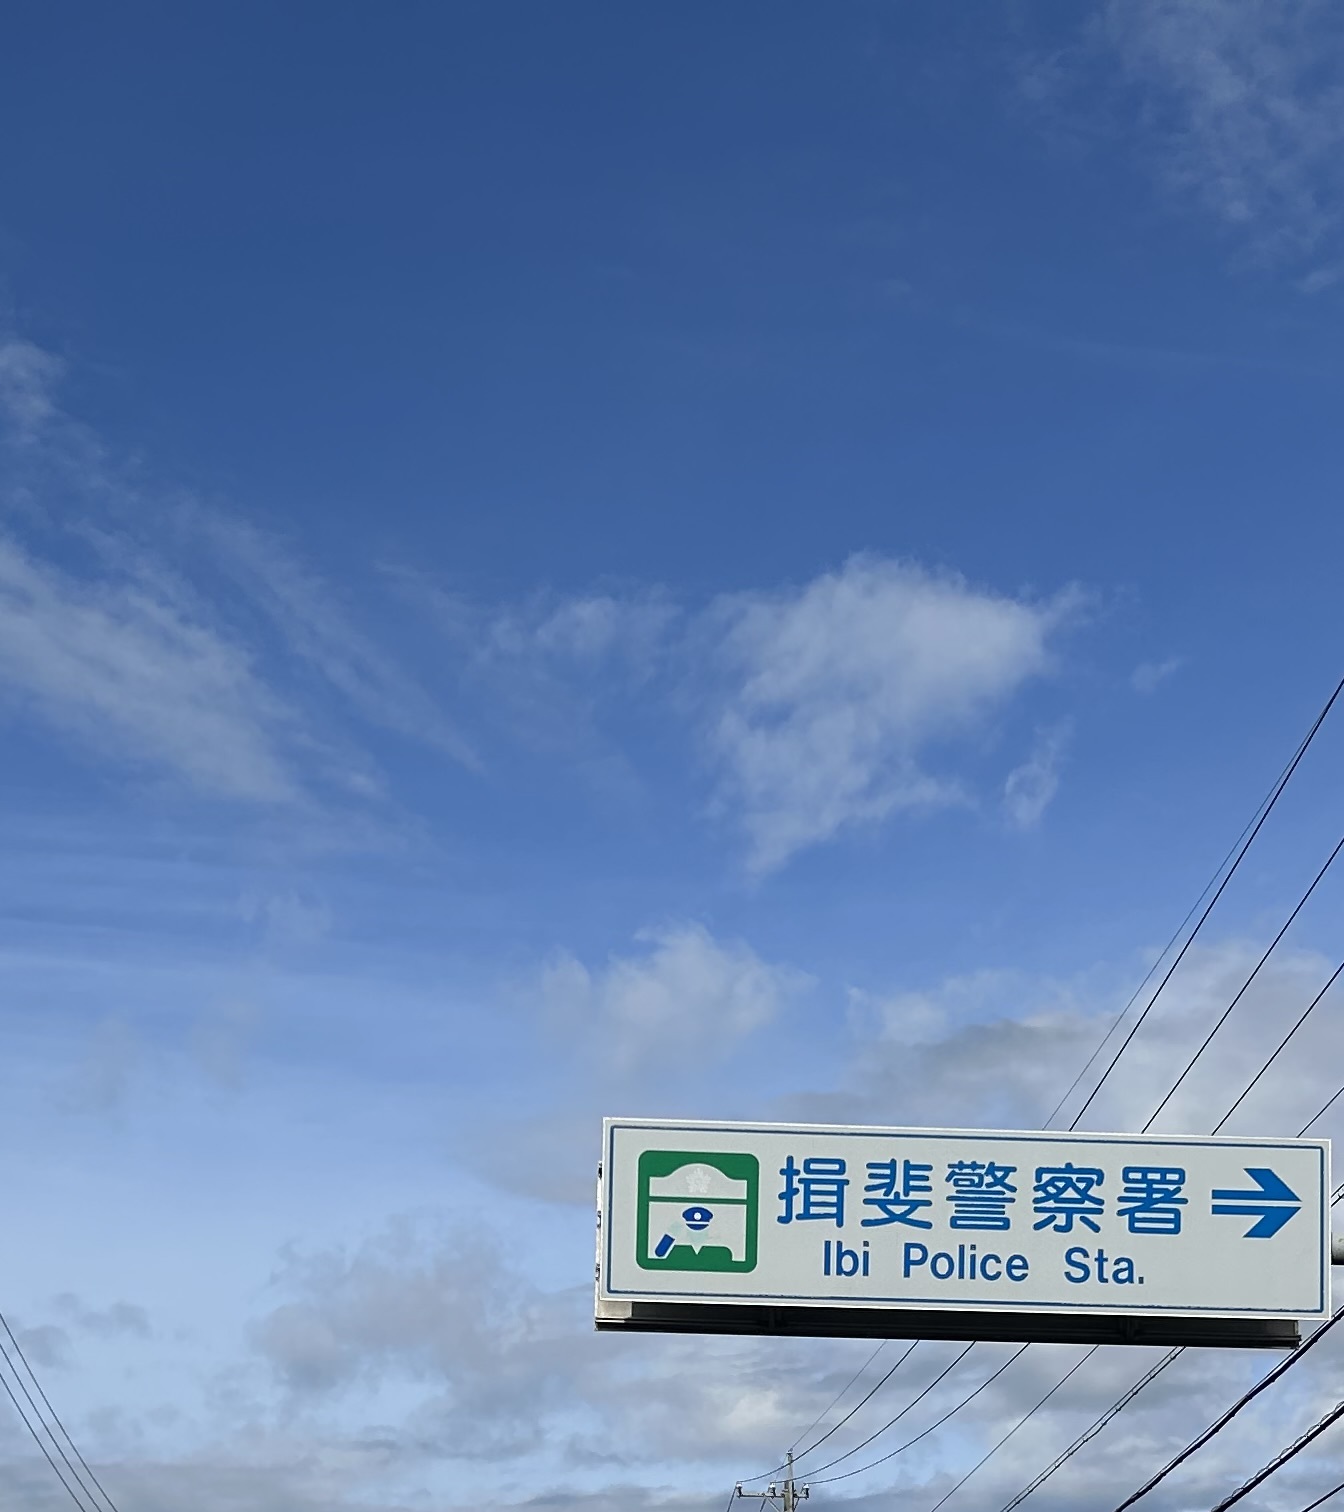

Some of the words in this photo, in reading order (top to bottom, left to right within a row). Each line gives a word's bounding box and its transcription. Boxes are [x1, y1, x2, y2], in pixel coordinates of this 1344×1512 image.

[776, 1154, 1188, 1236] 揖斐警察署
[822, 1240, 871, 1278] Ibi
[903, 1243, 1030, 1283] Police
[1063, 1246, 1146, 1286] Sta.
